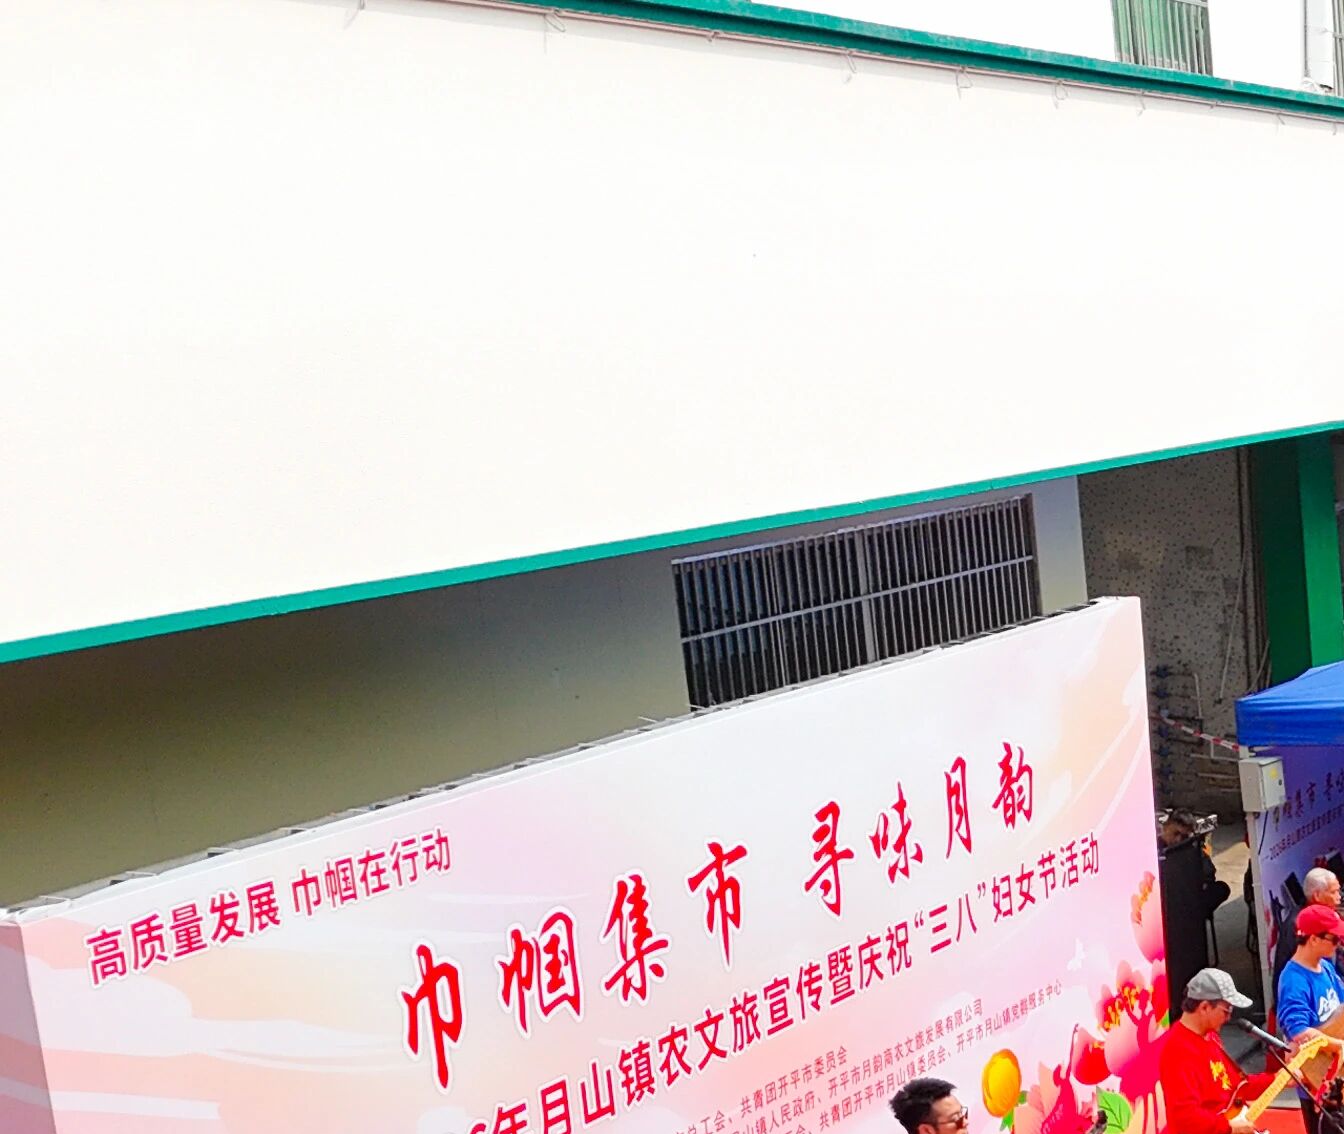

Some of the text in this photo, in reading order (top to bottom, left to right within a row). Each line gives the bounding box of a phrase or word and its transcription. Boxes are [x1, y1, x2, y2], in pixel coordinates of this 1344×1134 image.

[86, 828, 451, 985] 高质量发展 巾帼在行动
[403, 744, 1033, 1089] 巾帼集市 寻味月韵
